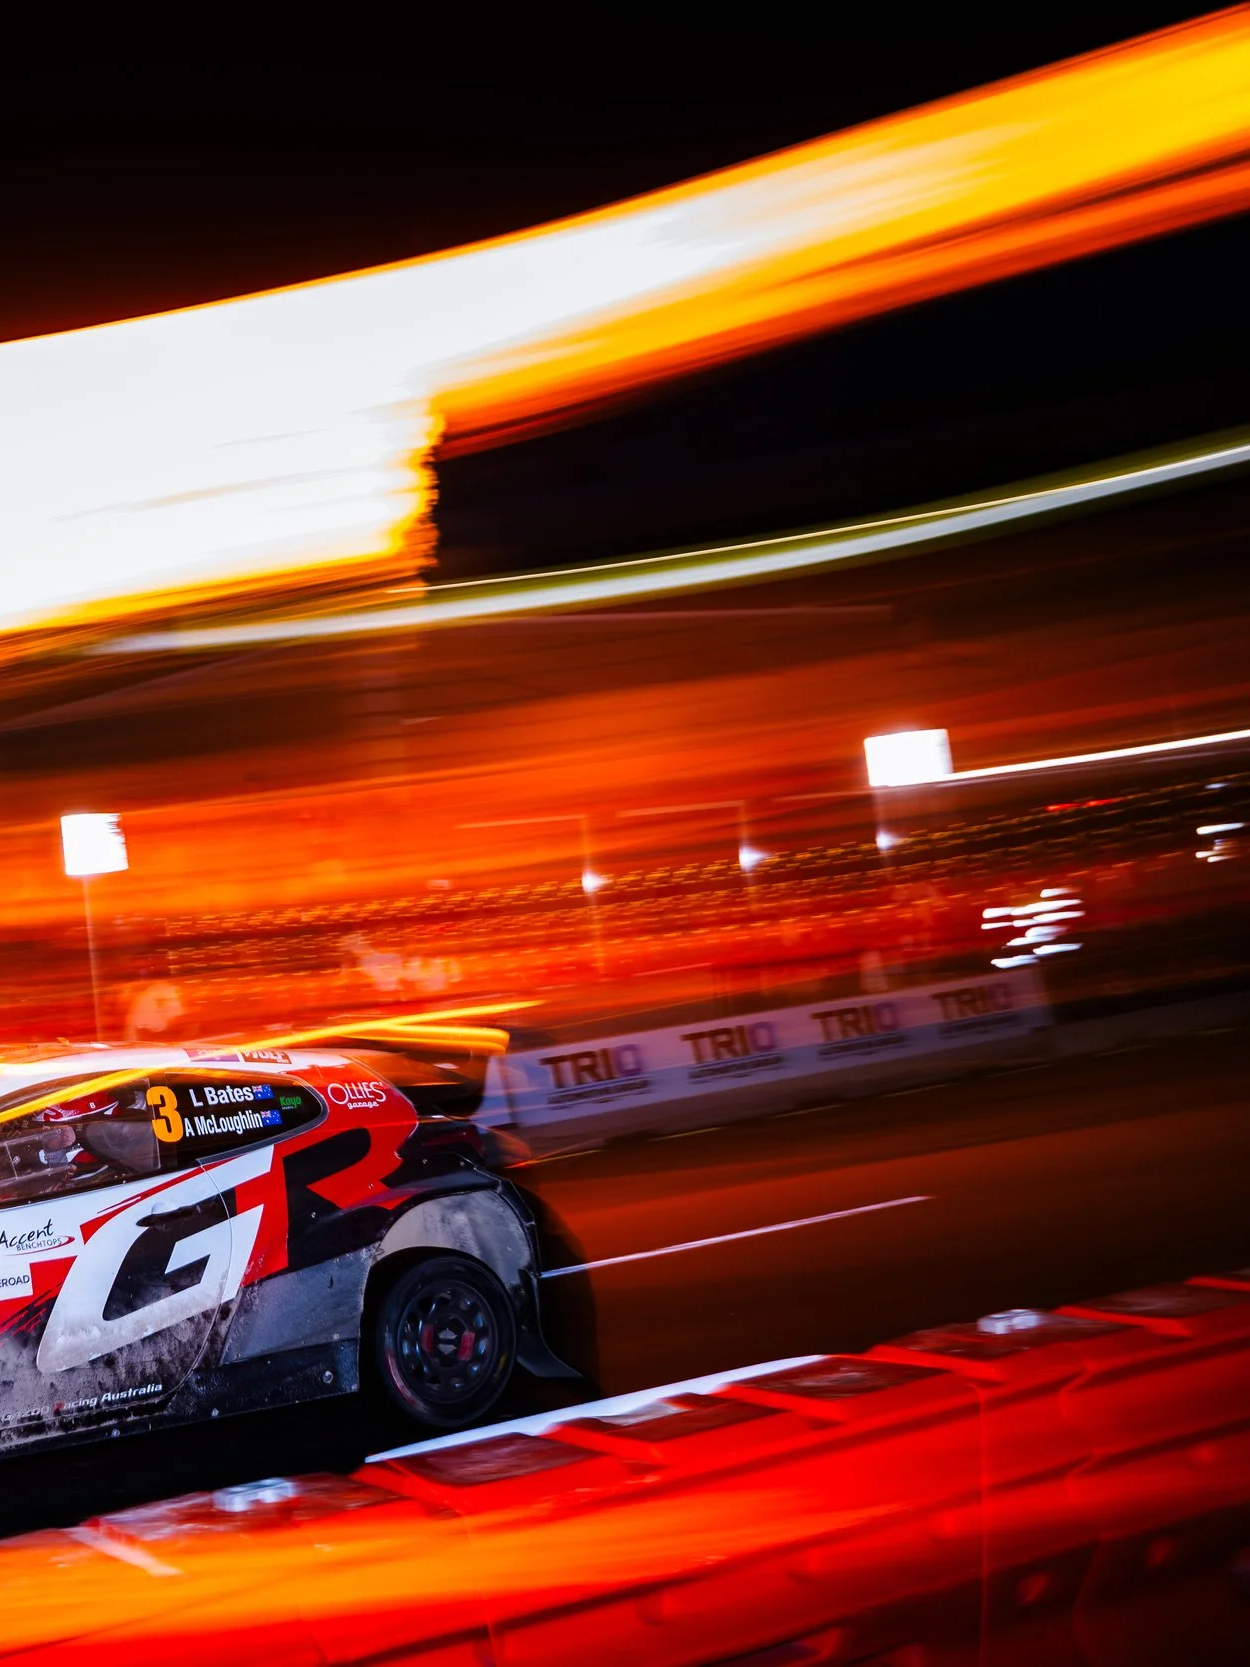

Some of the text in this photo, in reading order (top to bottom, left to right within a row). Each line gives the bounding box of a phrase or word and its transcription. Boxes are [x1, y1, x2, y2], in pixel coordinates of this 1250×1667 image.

[811, 1003, 899, 1042] TRIO
[681, 1020, 776, 1065] TRIO
[540, 1044, 643, 1088] TRIO
[189, 1086, 254, 1107] L Bates
[280, 1096, 302, 1109] Kayo
[347, 1101, 379, 1110] garage
[146, 1086, 184, 1143] 3
[184, 1110, 263, 1137] A McLoughlin
[16, 1237, 62, 1251] BENCHTOPS
[101, 1384, 162, 1402] Australia
